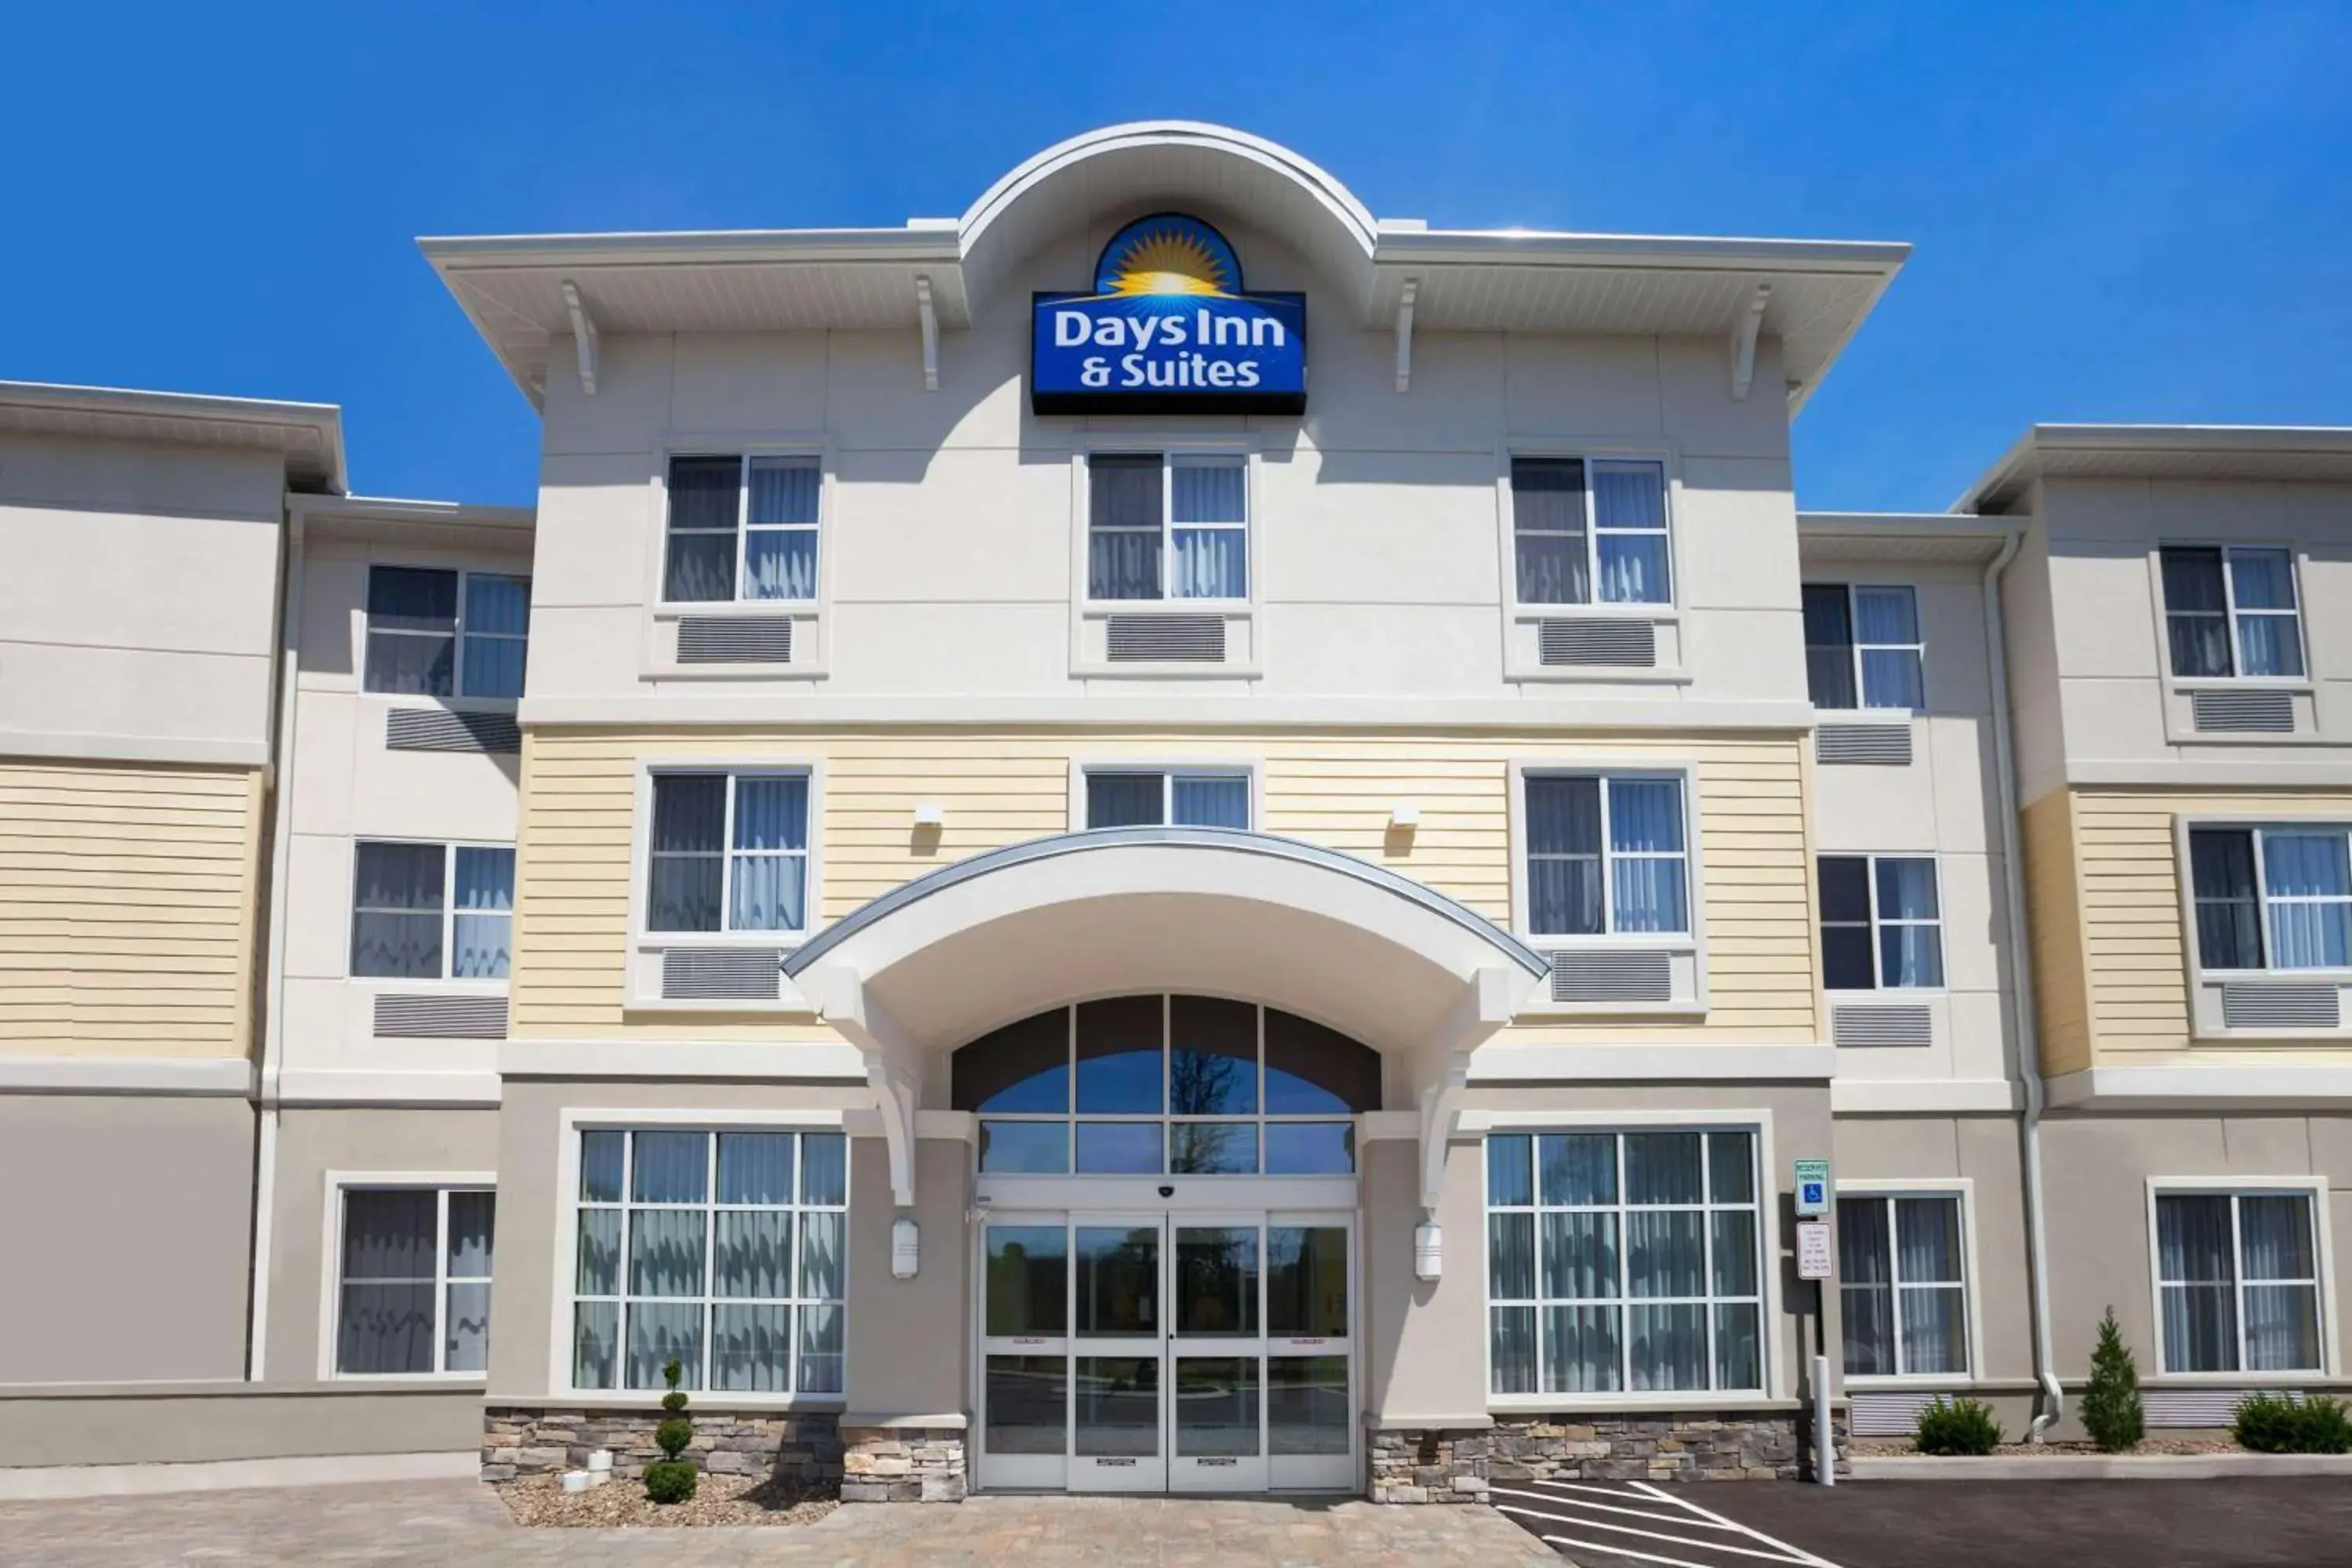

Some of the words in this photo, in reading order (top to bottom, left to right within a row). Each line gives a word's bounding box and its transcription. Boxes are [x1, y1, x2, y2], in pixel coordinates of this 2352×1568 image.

[1055, 310, 1186, 350] Days
[1197, 309, 1285, 346] Inn
[1080, 356, 1111, 387] &
[1120, 353, 1260, 387] Suites
